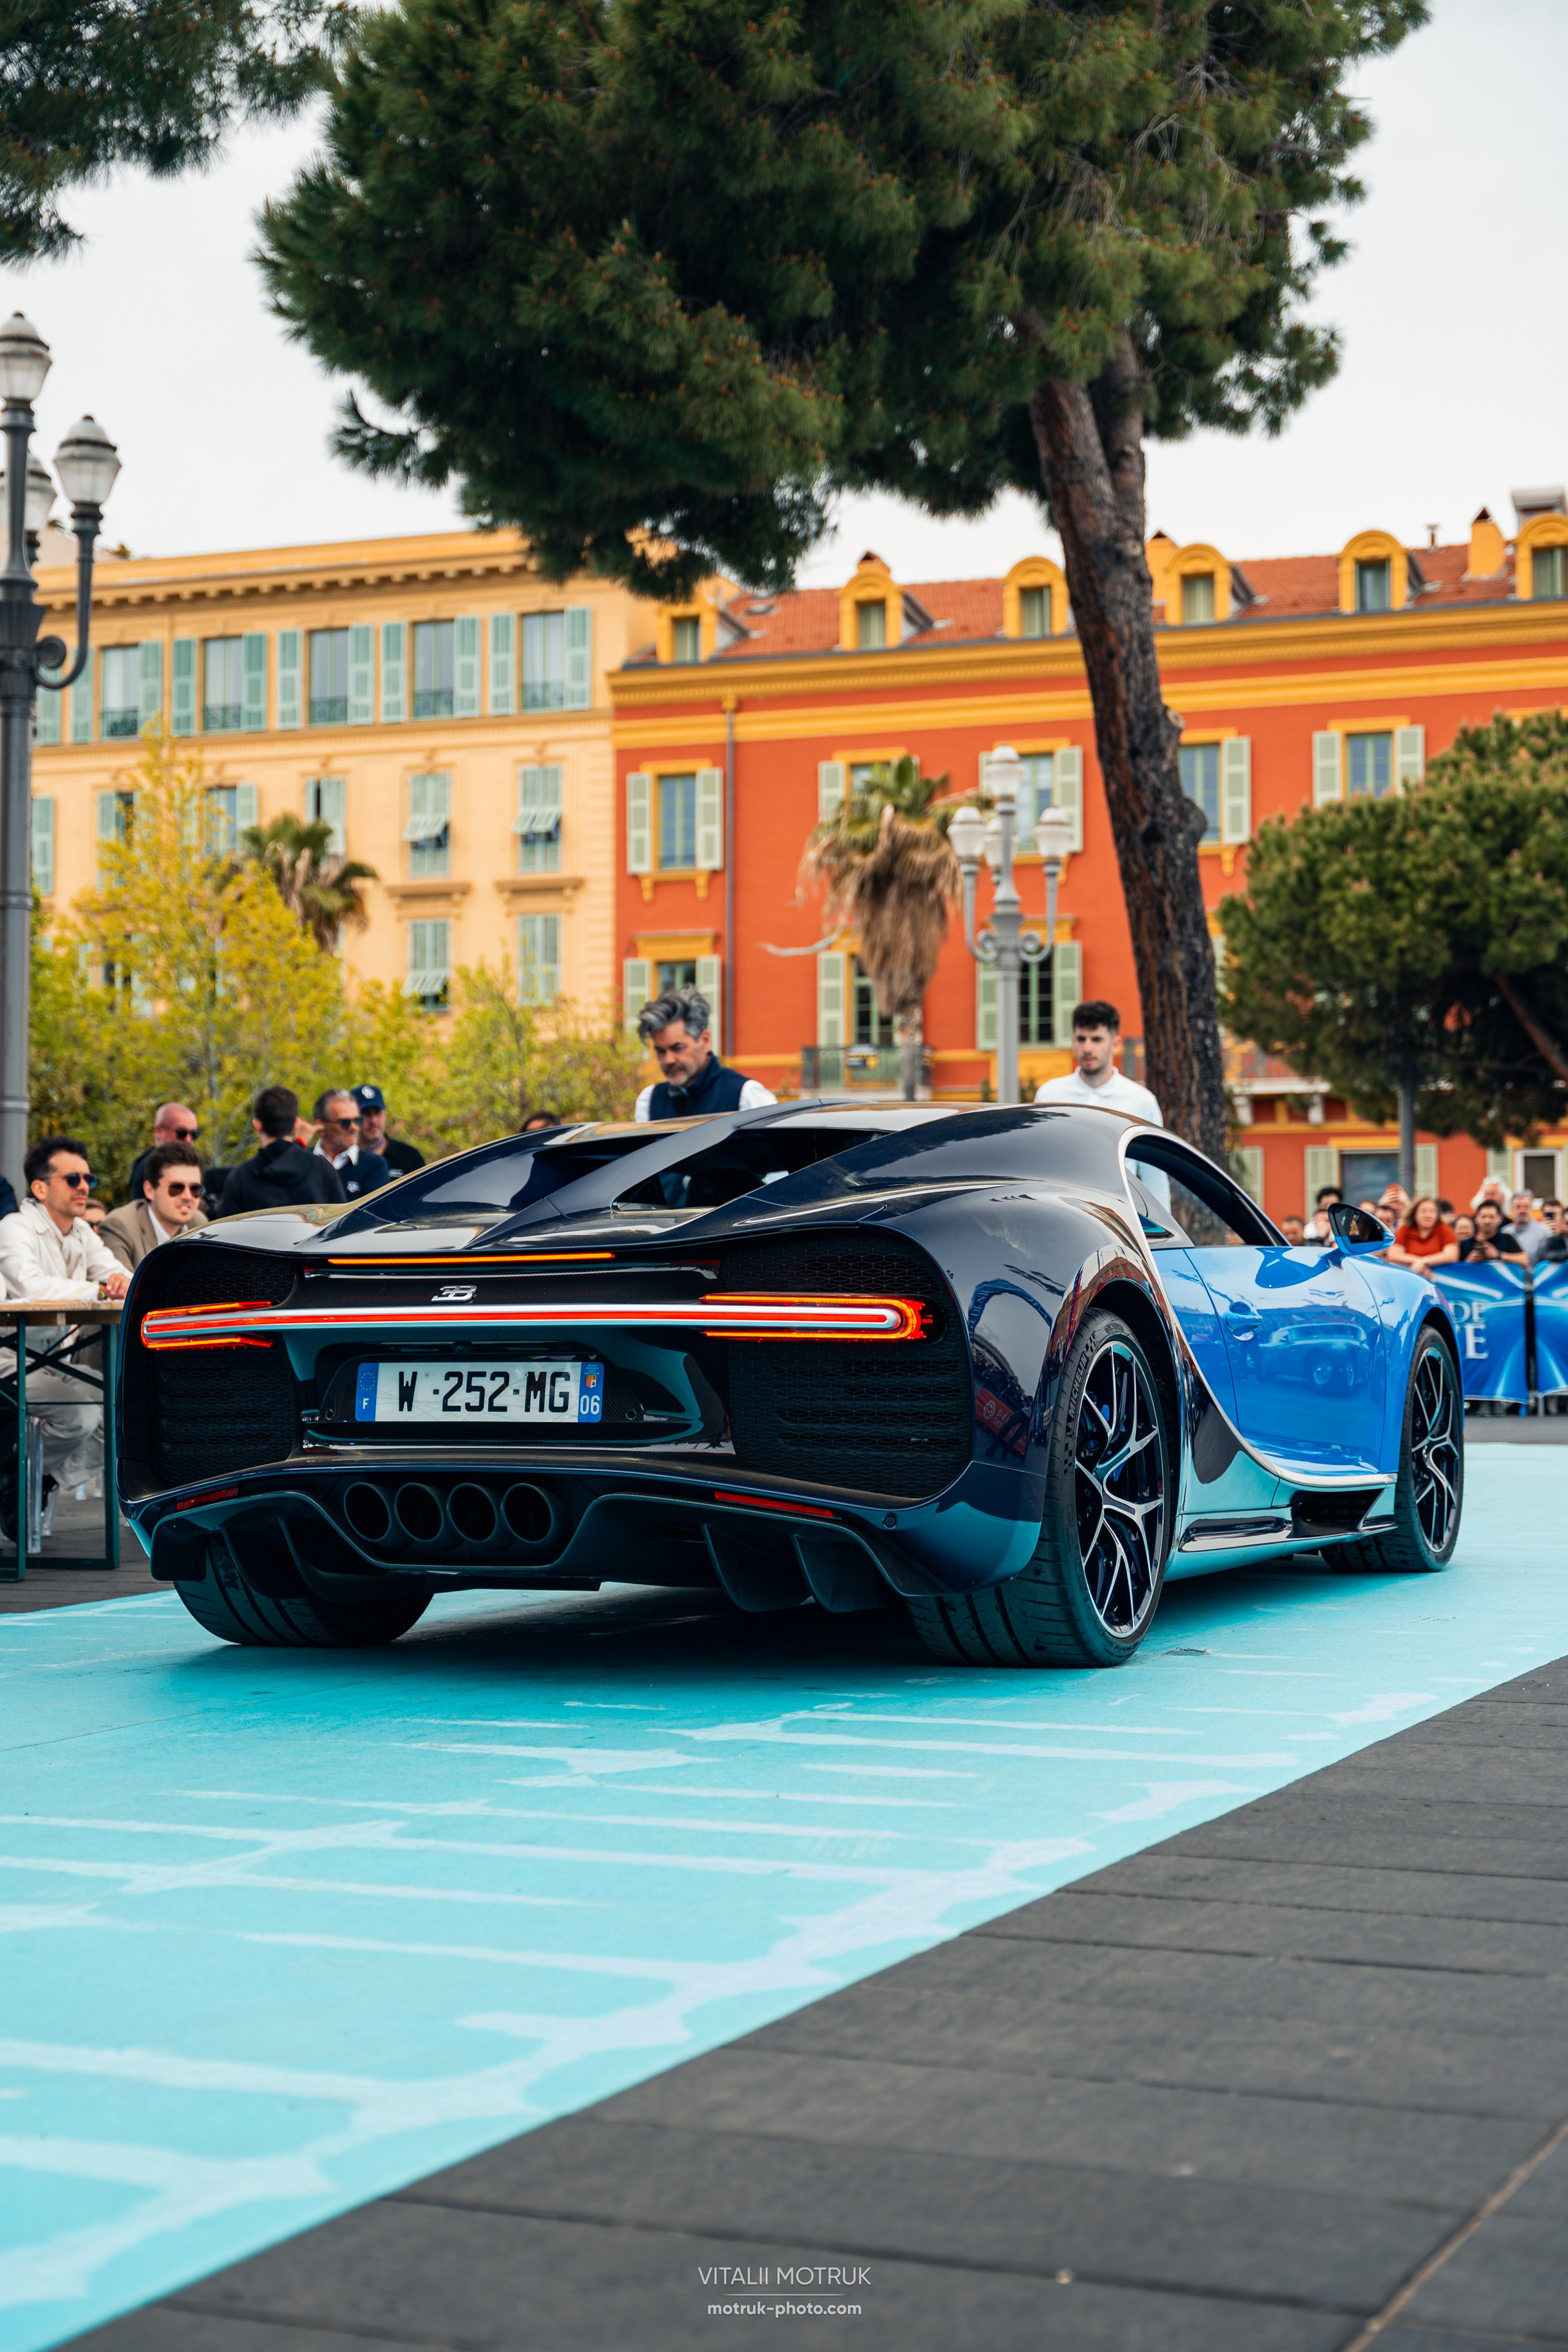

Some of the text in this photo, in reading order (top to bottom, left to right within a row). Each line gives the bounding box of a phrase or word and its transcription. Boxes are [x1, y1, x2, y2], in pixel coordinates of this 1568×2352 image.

[1068, 1353, 1087, 1419] MICHELIN
[363, 1398, 370, 1410] F
[579, 1394, 601, 1415] 06
